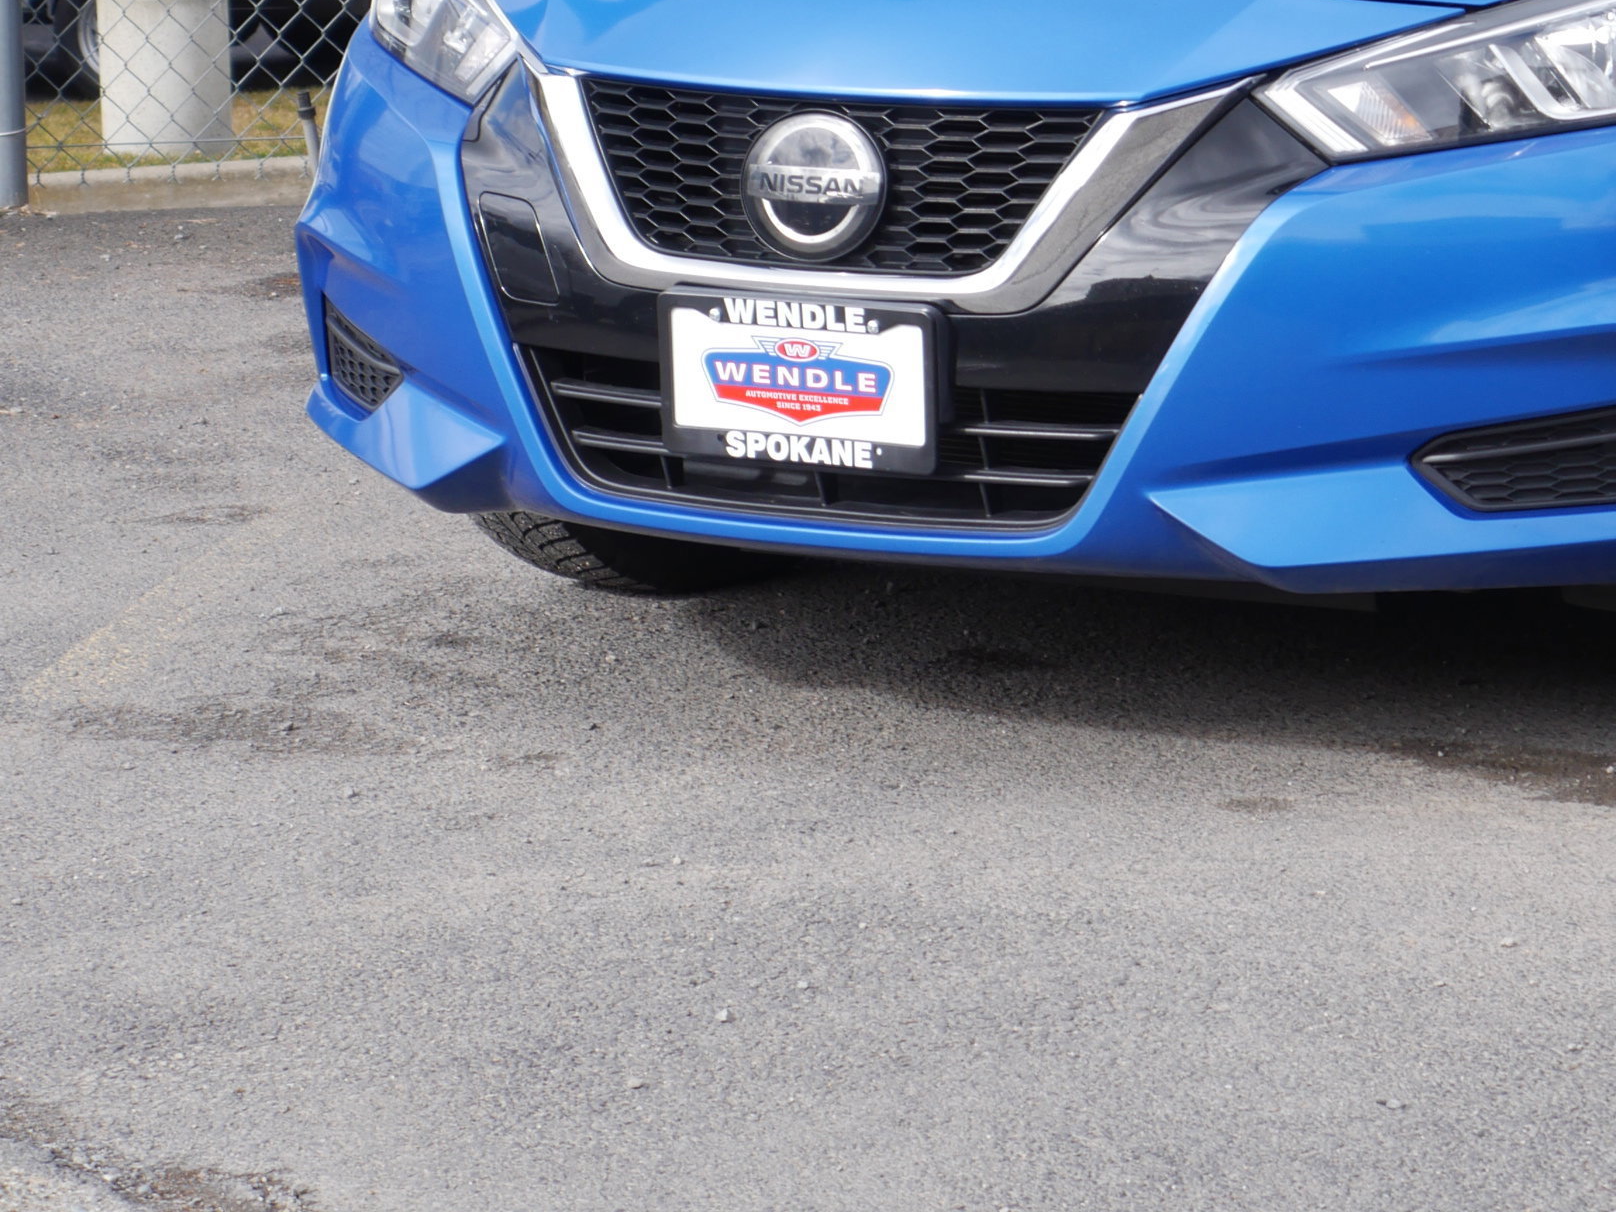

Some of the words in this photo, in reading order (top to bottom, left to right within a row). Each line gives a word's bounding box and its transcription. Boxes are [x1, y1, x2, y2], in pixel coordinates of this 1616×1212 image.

[759, 172, 865, 198] NISSAN
[723, 297, 867, 334] WENDLE
[714, 360, 878, 394] WENDLE
[745, 390, 797, 401] AUTOMOTIVE
[798, 394, 849, 405] EXCELLENCE
[776, 401, 801, 410] SINCE
[801, 403, 822, 412] 1943
[725, 429, 874, 470] SPOKANE
